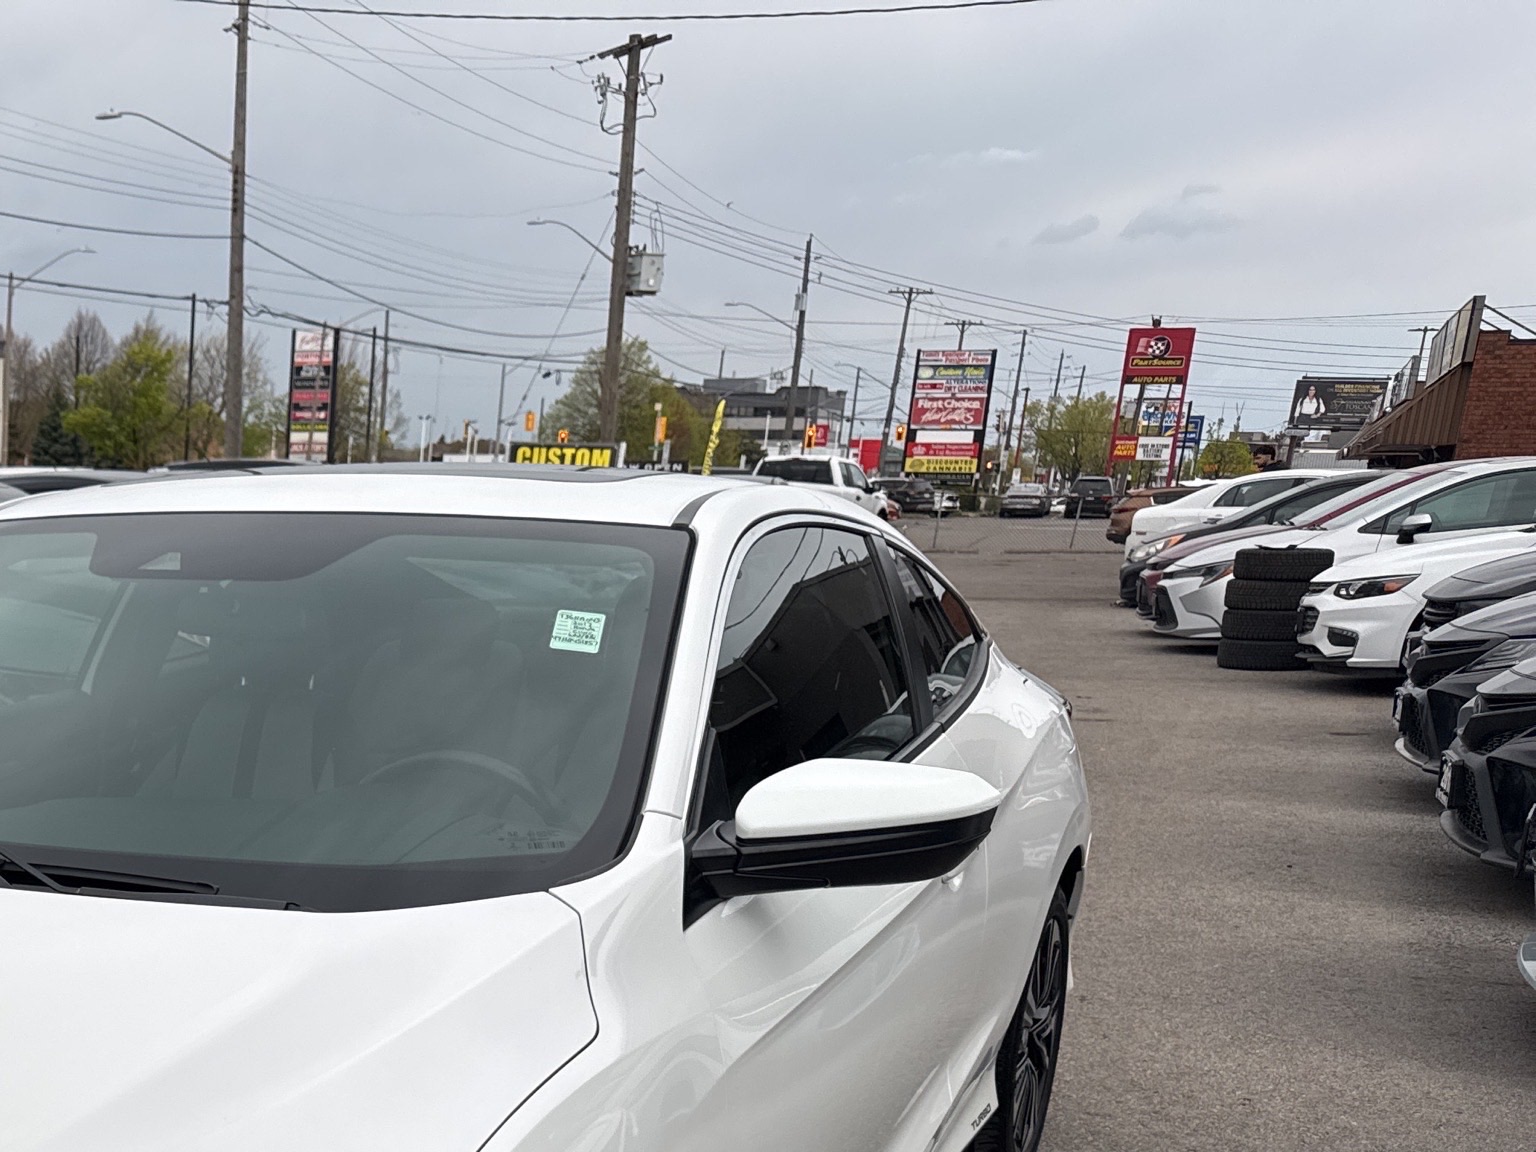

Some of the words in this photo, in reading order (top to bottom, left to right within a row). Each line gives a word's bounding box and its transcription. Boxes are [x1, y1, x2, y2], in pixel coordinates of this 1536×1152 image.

[944, 385, 957, 393] DRY
[958, 385, 986, 393] CLEANING
[918, 398, 944, 409] First
[944, 398, 981, 409] Choice
[516, 446, 612, 468] CUSTOM
[971, 1103, 992, 1131] TURBO
